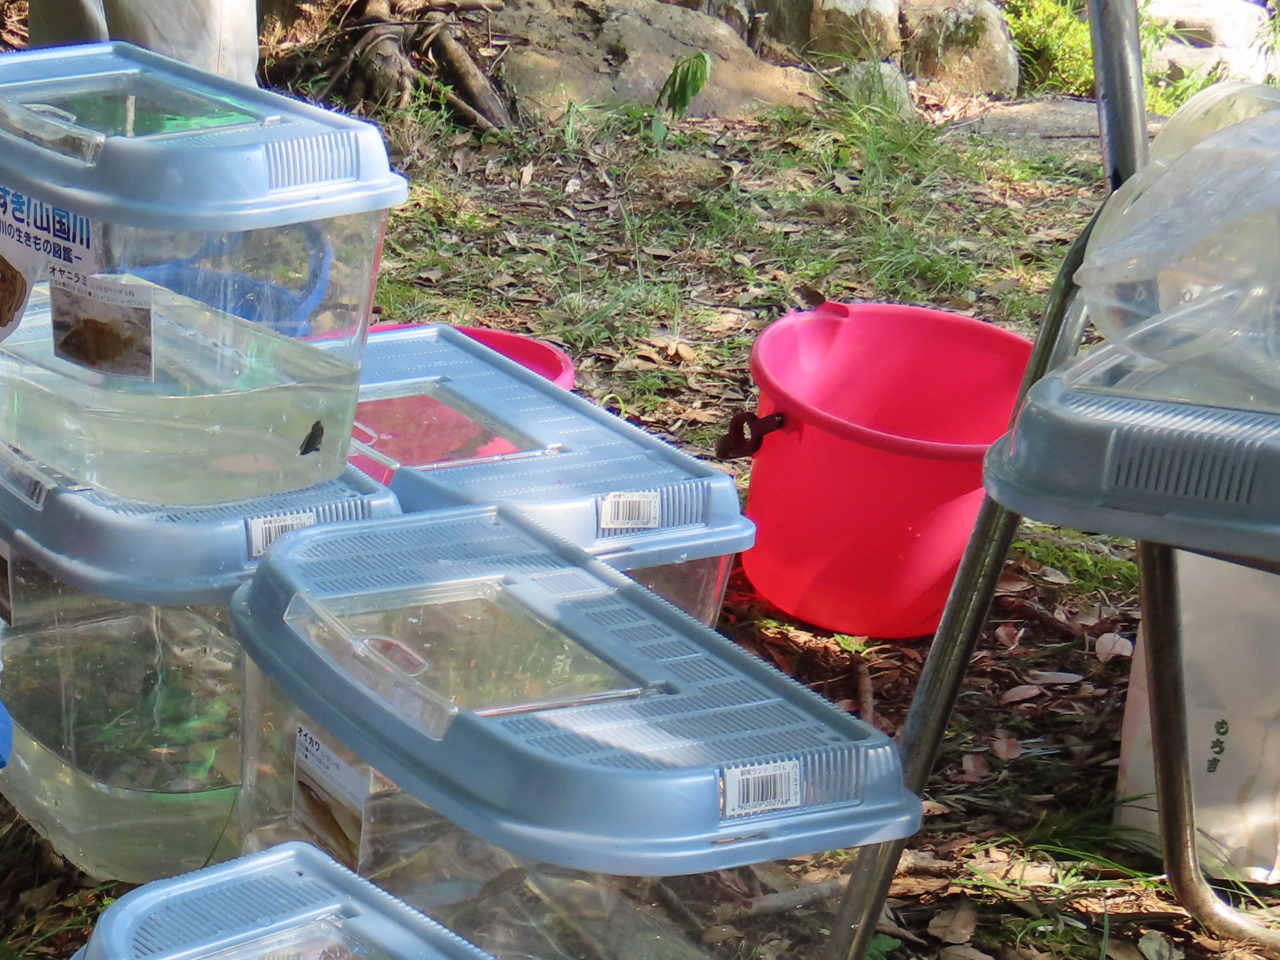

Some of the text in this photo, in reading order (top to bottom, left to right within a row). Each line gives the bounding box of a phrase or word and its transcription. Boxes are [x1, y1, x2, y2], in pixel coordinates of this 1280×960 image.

[49, 265, 88, 286] オヤニラミ
